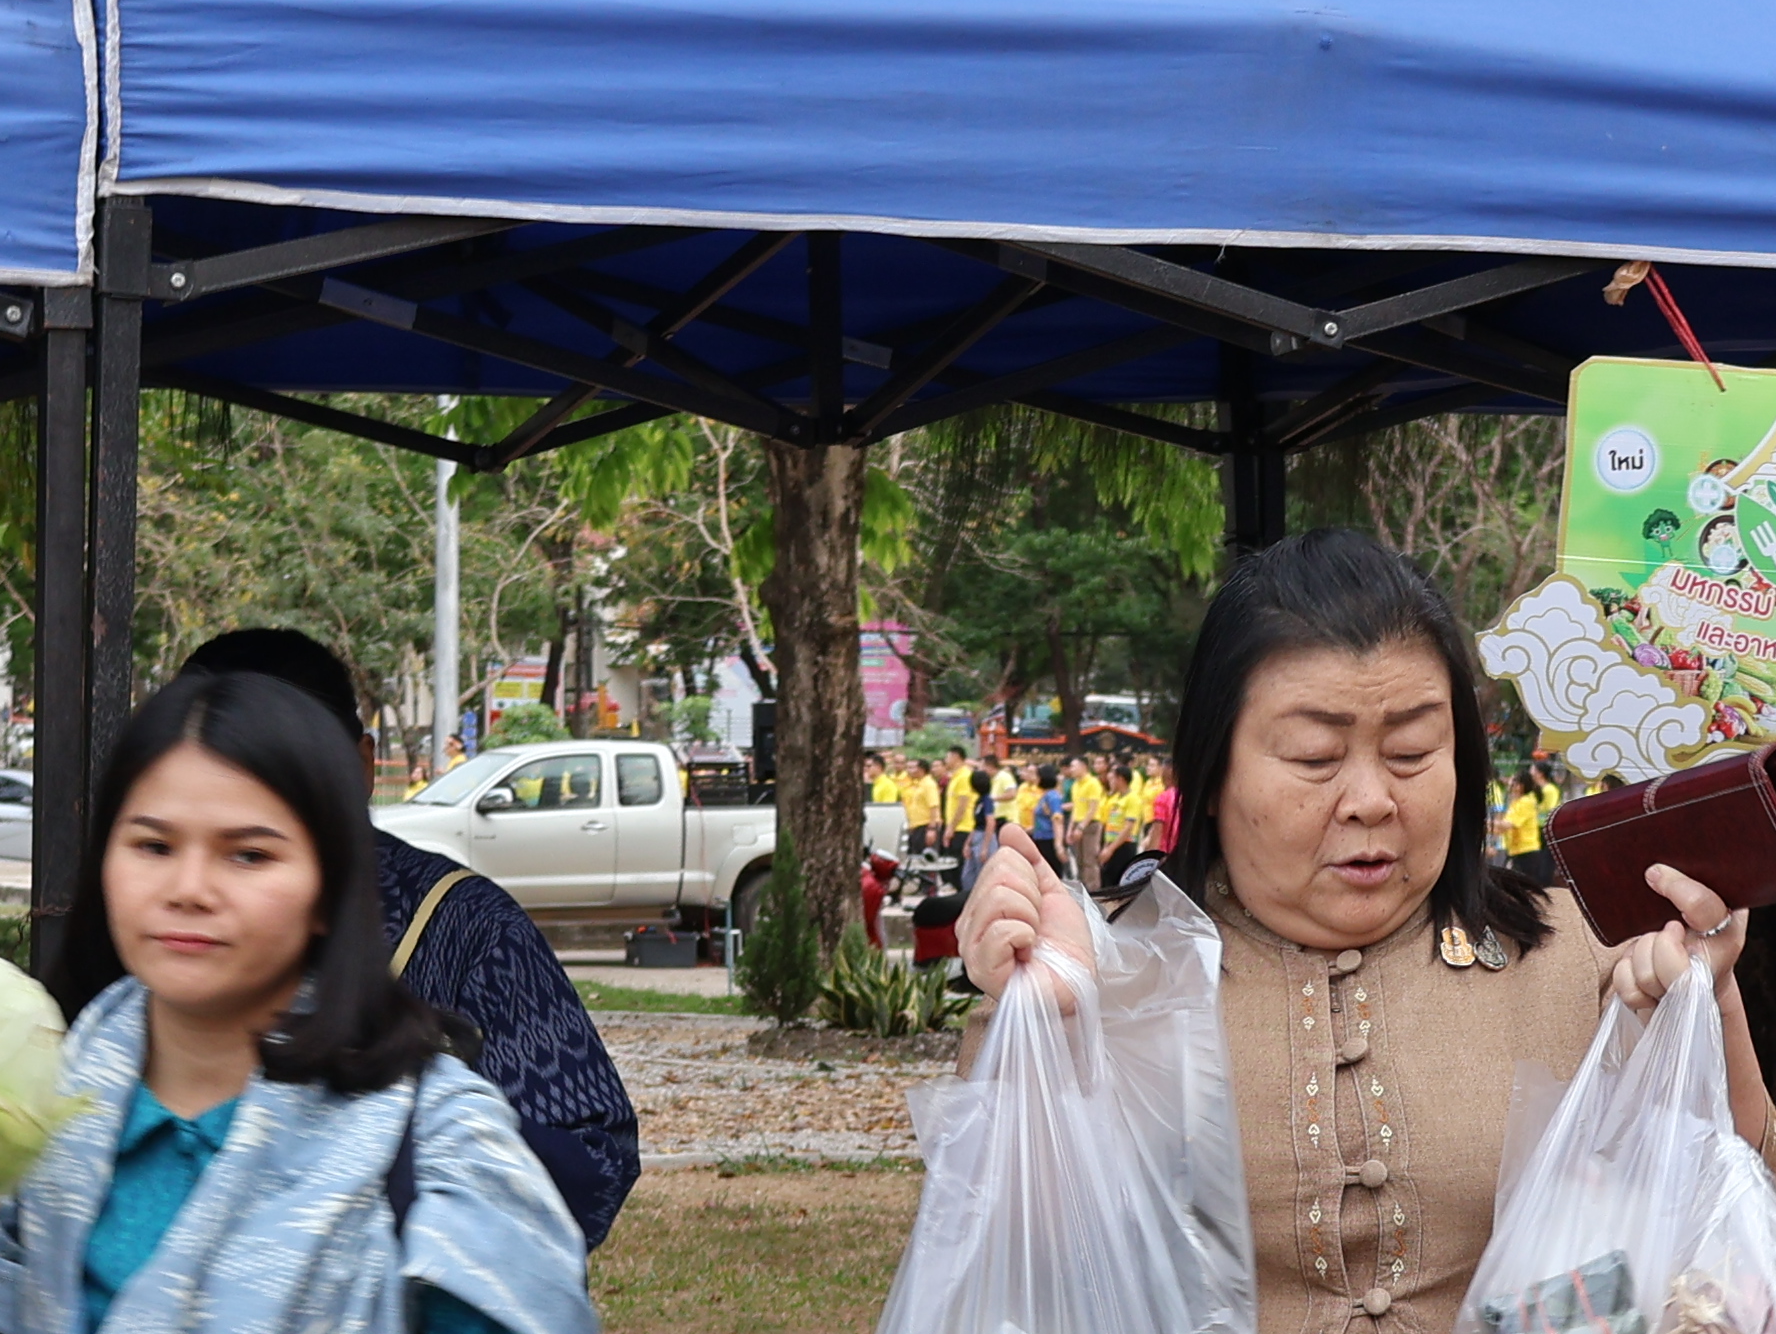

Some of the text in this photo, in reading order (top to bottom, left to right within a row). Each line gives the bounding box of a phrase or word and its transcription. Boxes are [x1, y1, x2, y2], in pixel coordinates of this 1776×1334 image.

[1608, 448, 1644, 471] ใหม่
[1670, 568, 1774, 616] มหกรรม
